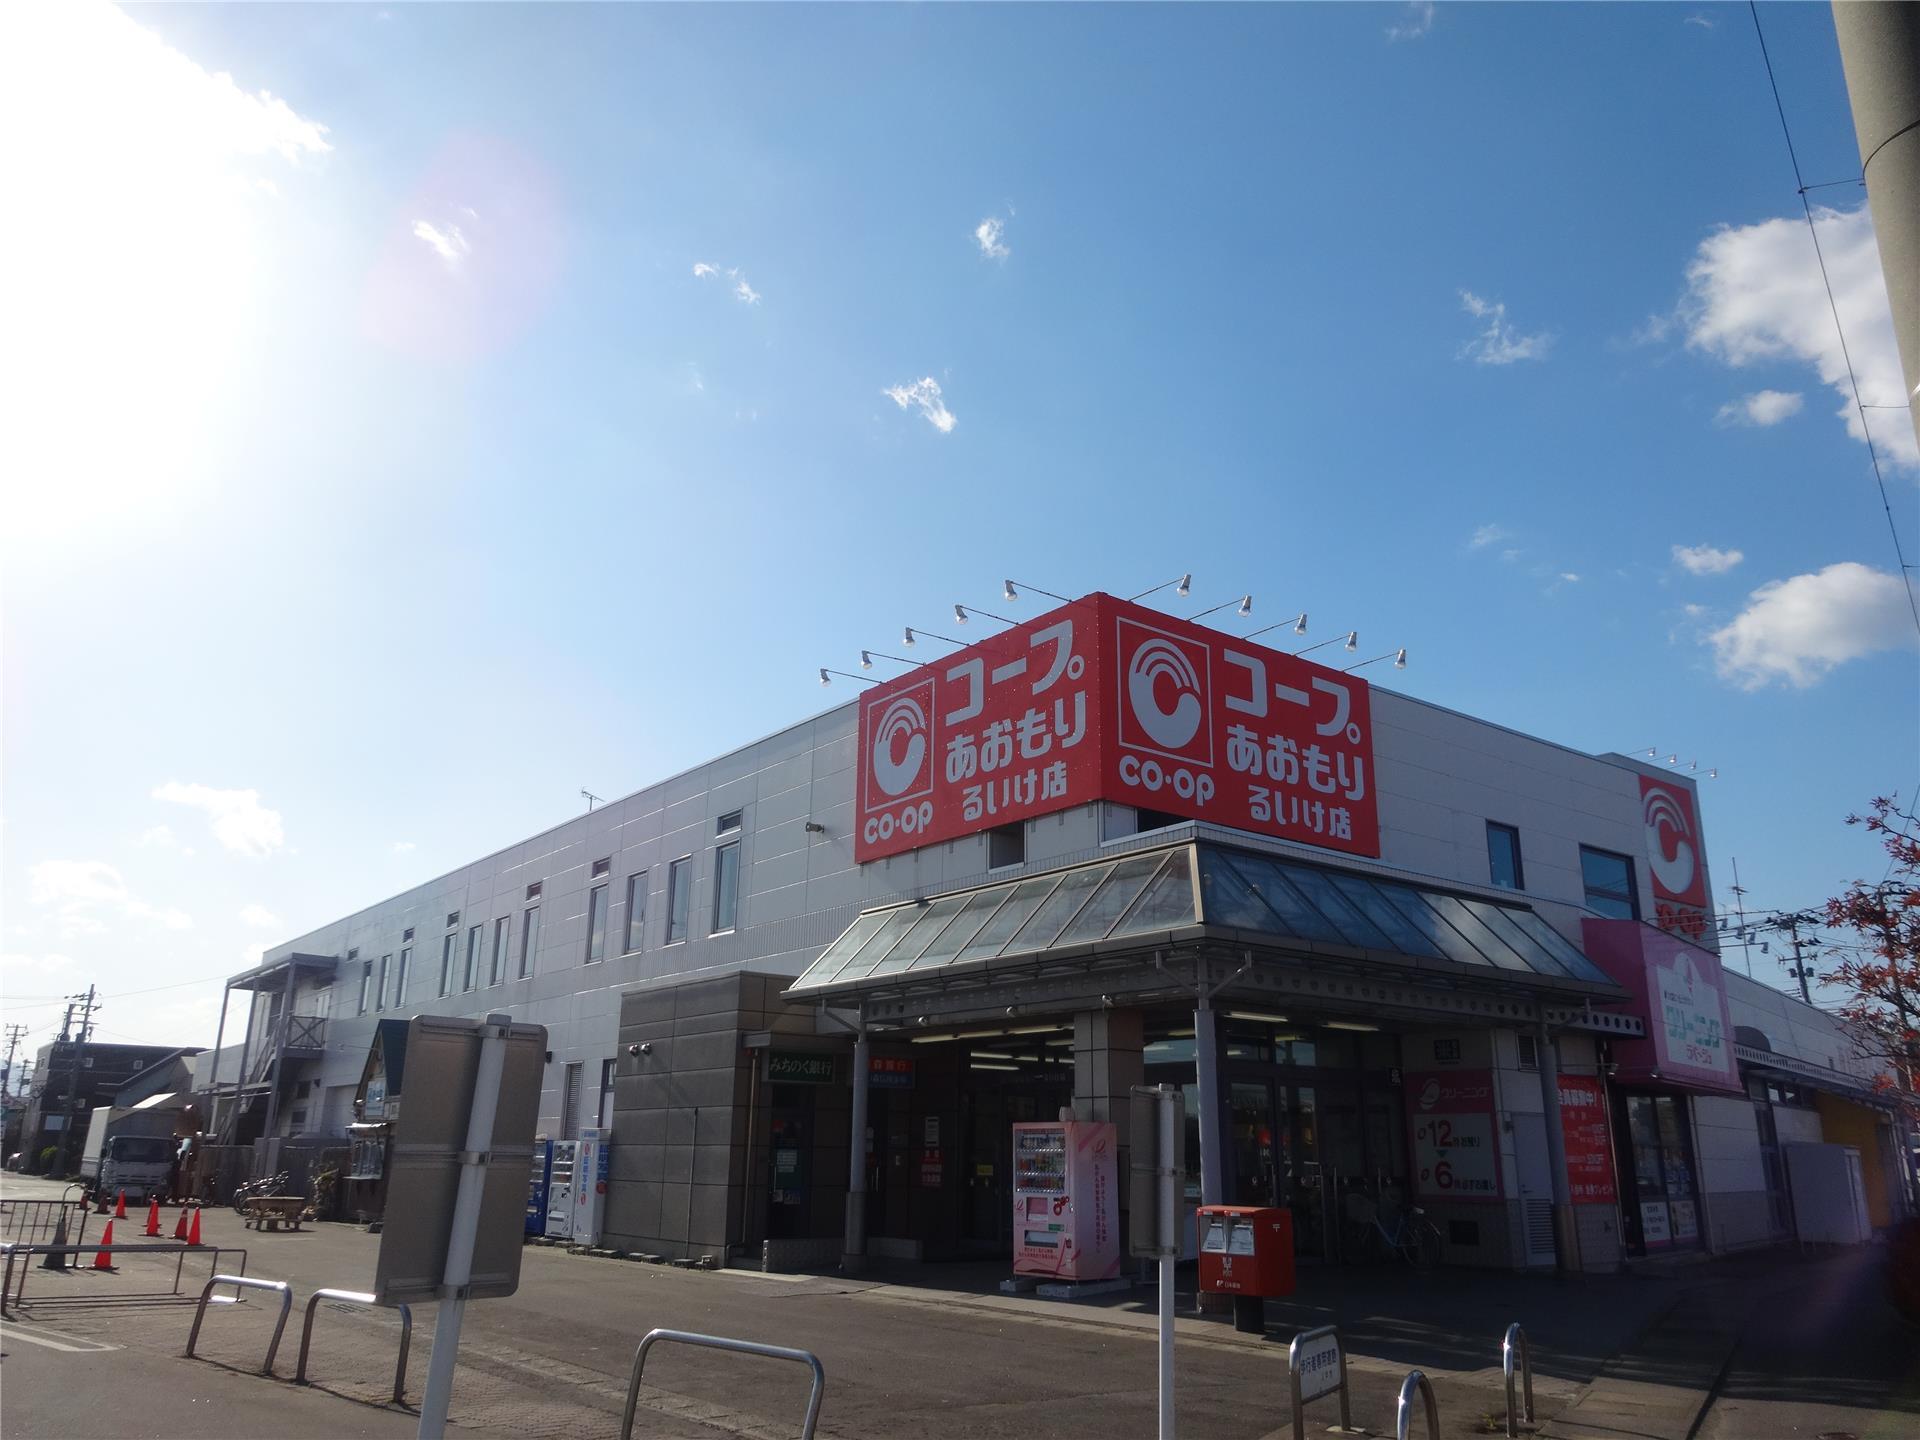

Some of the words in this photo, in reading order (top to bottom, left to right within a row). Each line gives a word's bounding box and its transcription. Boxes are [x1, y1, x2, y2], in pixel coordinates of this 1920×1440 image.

[945, 690, 1087, 784] あおもり
[1226, 724, 1364, 801] あおもり
[962, 760, 1068, 821] るいけ店
[1248, 785, 1351, 841] るいけ店
[769, 1056, 832, 1075] みちのく銀行
[1440, 1087, 1490, 1099] クリーニング
